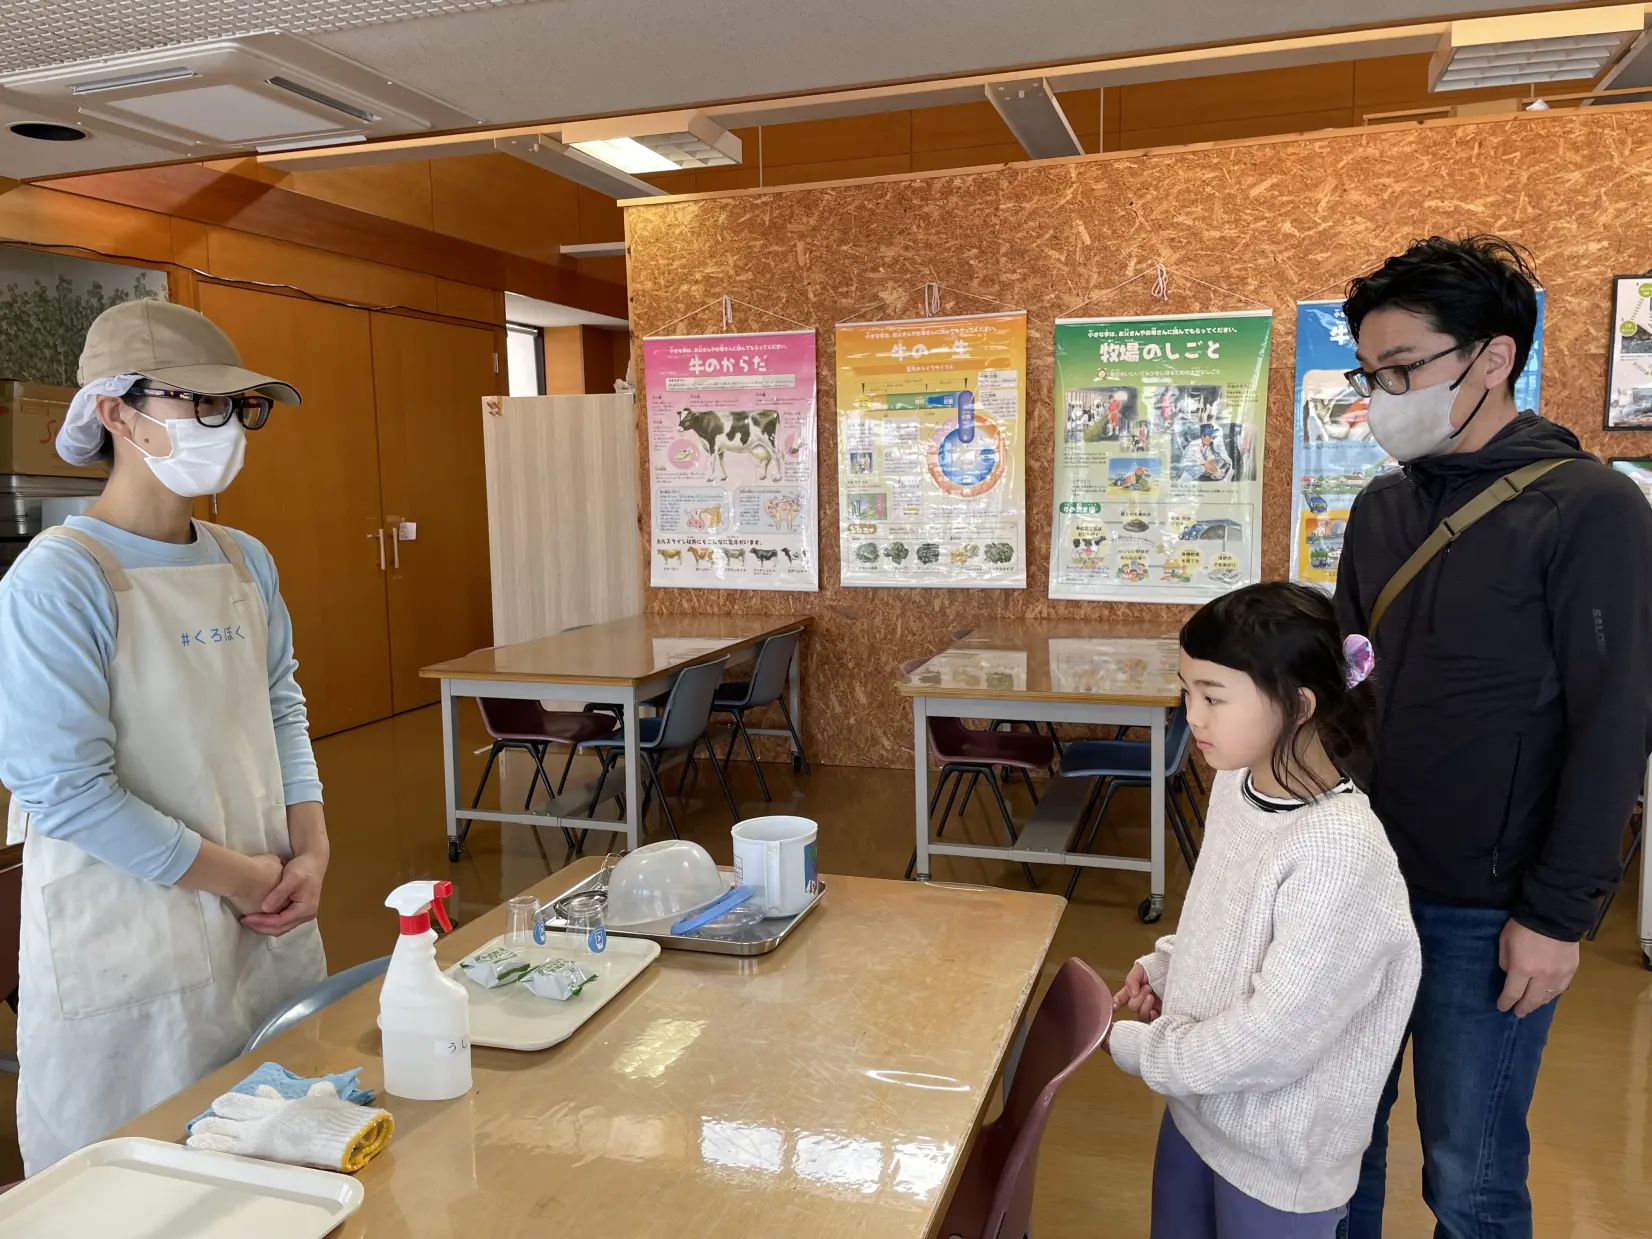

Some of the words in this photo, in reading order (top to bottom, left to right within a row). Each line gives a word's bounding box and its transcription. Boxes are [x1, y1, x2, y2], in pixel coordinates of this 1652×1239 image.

[1088, 327, 1237, 338] 小さな子は、お父さんやお母さんに読んでもらってください。
[891, 340, 971, 361] 牛の一生
[1100, 339, 1221, 363] 牧場のしごと
[688, 354, 769, 374] 牛のからだ
